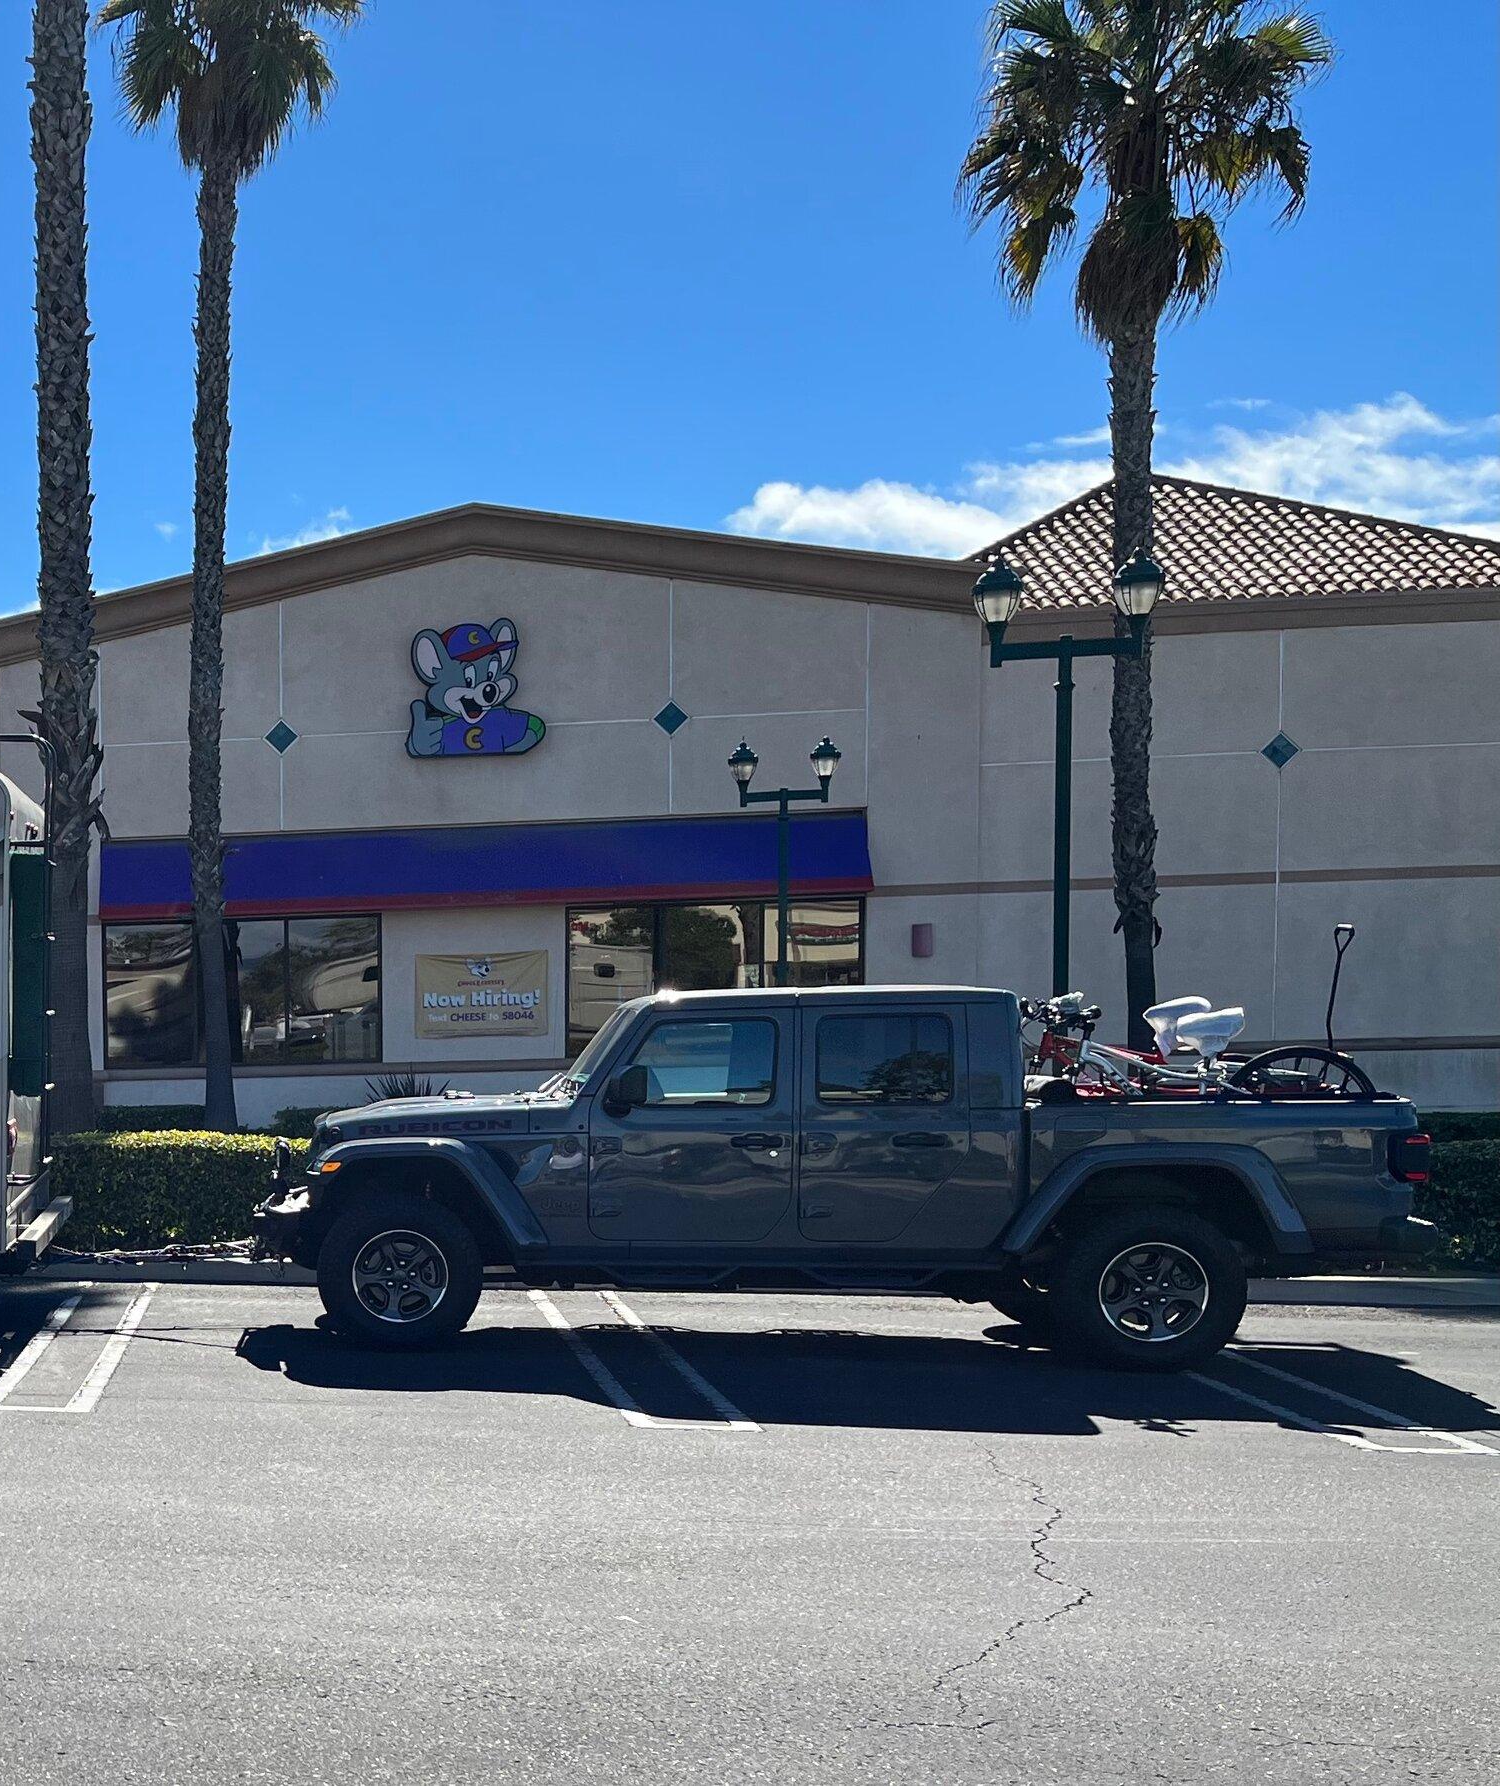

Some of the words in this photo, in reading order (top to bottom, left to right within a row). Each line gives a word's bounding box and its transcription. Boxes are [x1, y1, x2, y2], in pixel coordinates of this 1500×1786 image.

[468, 631, 480, 644] C
[463, 726, 484, 751] C
[423, 992, 466, 1009] Now
[471, 988, 541, 1010] Hiring!
[450, 1013, 487, 1021] CHEESE
[488, 1012, 499, 1021] to
[502, 1011, 534, 1020] 58046
[359, 1119, 512, 1135] RUBICON
[540, 1198, 581, 1213] Jeep
